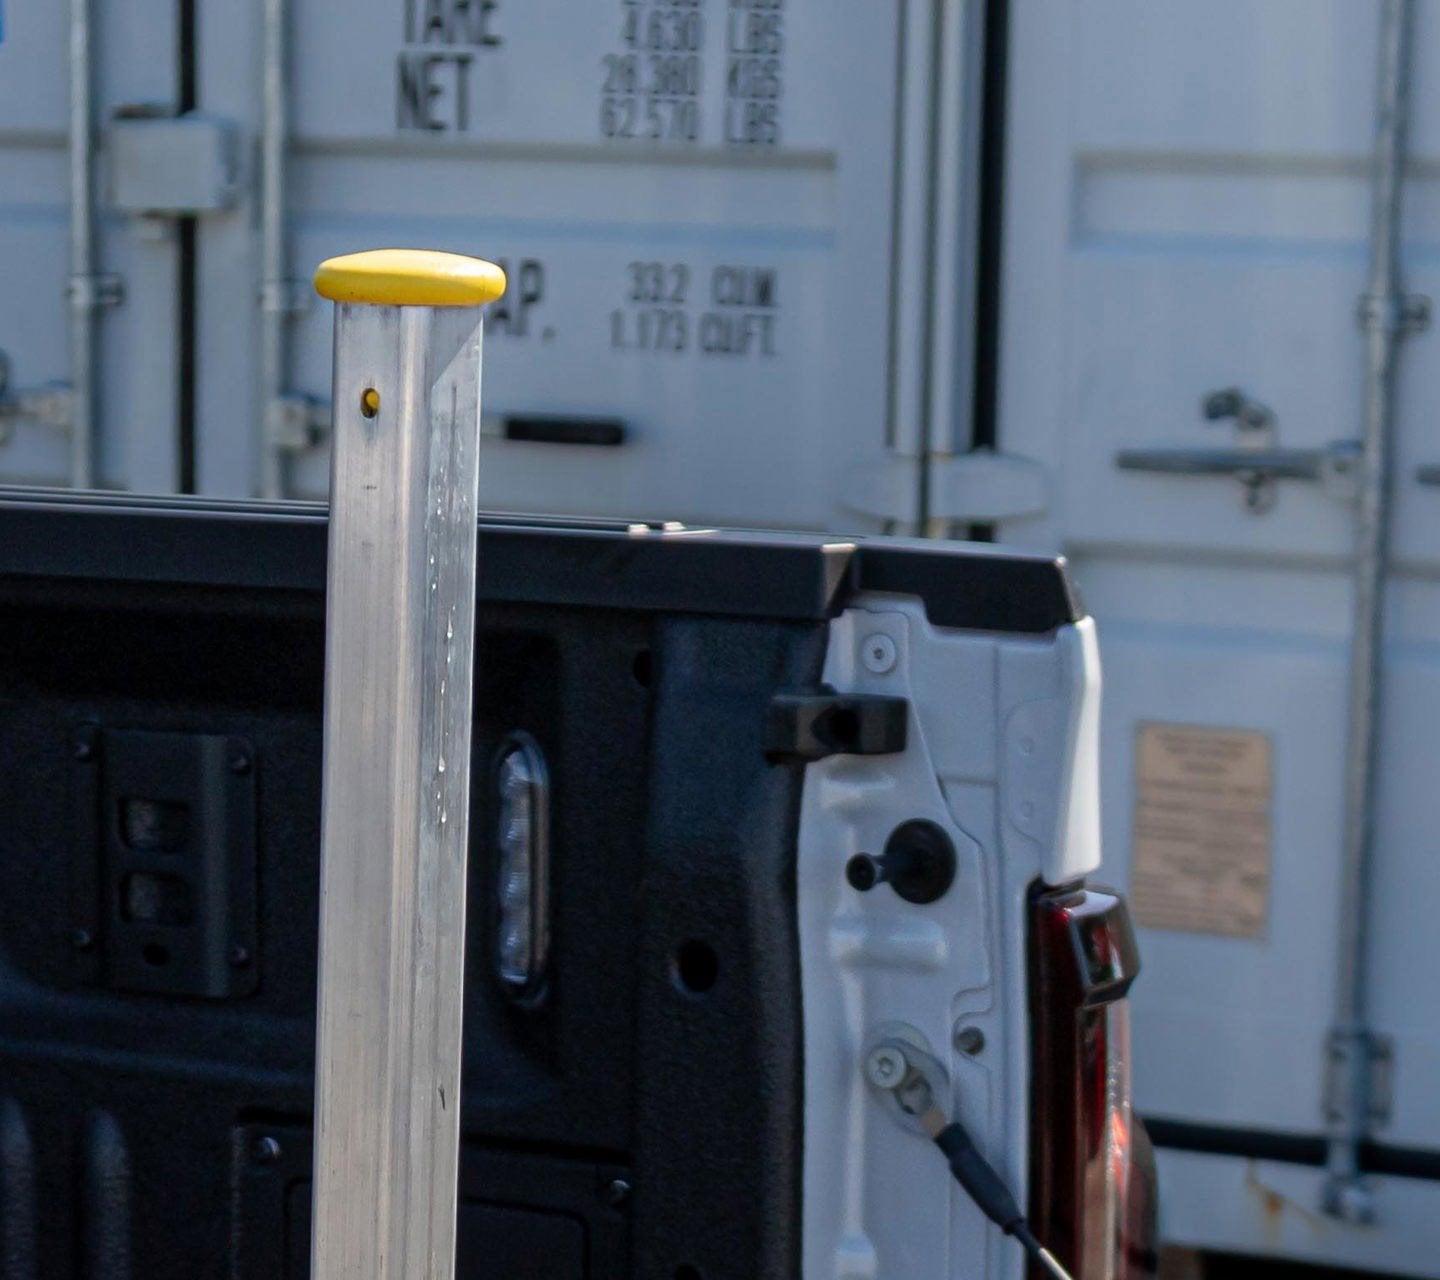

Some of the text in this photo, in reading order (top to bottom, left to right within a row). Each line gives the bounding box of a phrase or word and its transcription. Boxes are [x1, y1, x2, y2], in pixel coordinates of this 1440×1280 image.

[727, 11, 782, 54] LBS
[396, 51, 474, 131] NET
[726, 56, 783, 98] KGS
[725, 99, 781, 144] LBS
